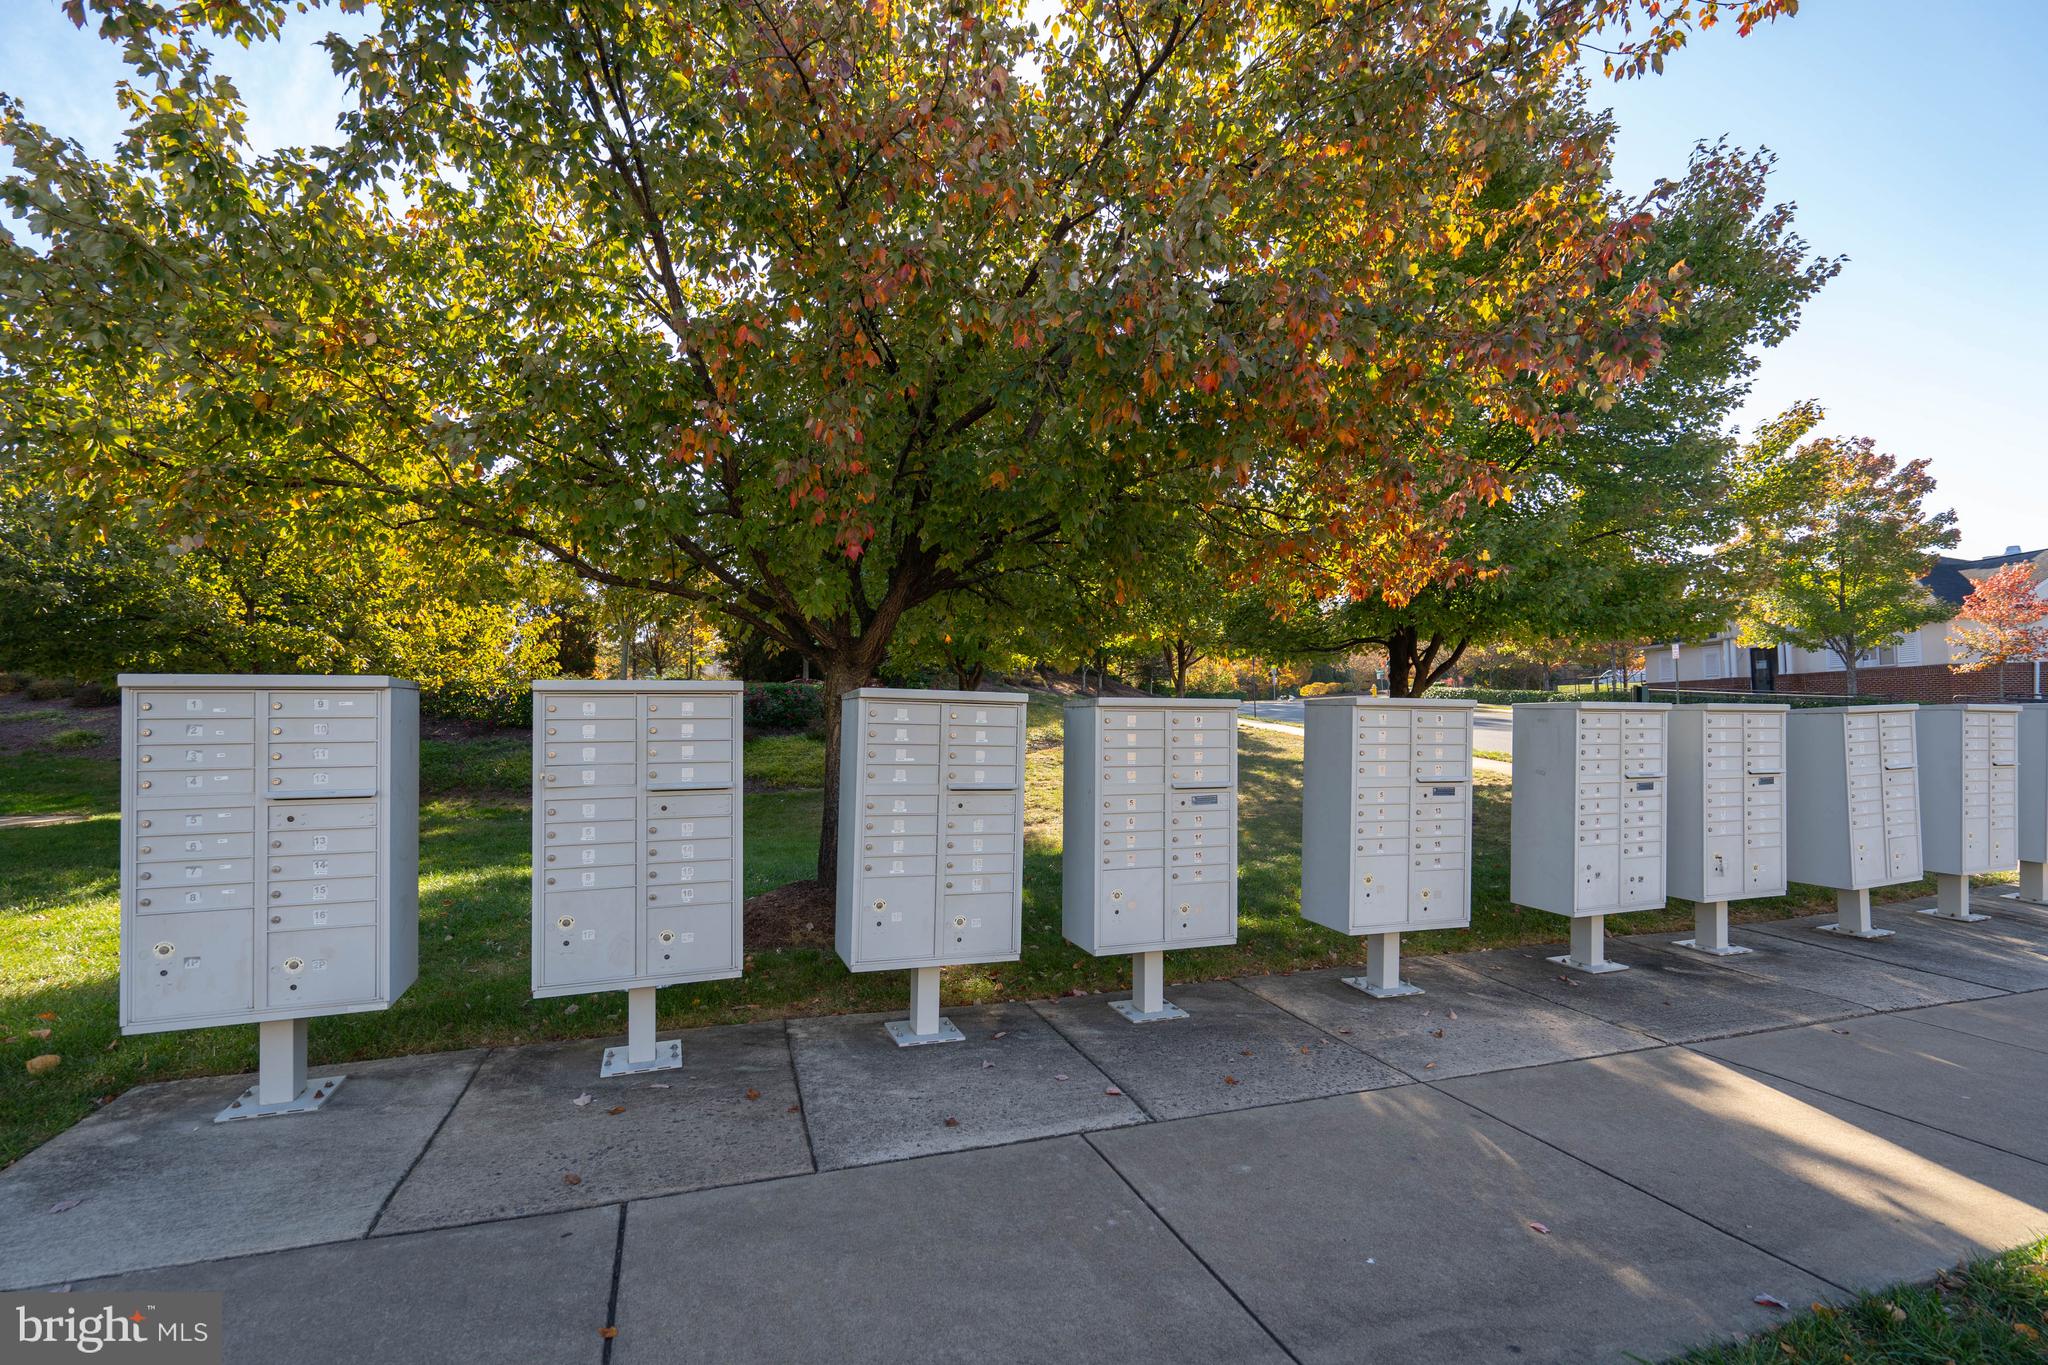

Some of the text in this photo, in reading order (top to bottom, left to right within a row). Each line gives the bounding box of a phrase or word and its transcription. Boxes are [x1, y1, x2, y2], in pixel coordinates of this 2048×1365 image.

[191, 700, 197, 709] 1
[317, 700, 324, 709] 9
[190, 726, 197, 735] 2
[315, 725, 326, 734] 10
[190, 752, 197, 760] 3
[315, 749, 326, 758] 11
[190, 778, 197, 786] 4
[315, 774, 326, 783] 12
[190, 815, 197, 824] 5
[314, 837, 326, 845] 13
[190, 866, 197, 875] 7
[314, 862, 327, 870] 14
[314, 886, 326, 894] 15
[190, 893, 196, 902] 8
[314, 911, 326, 919] 16
[312, 961, 326, 969] 2P
